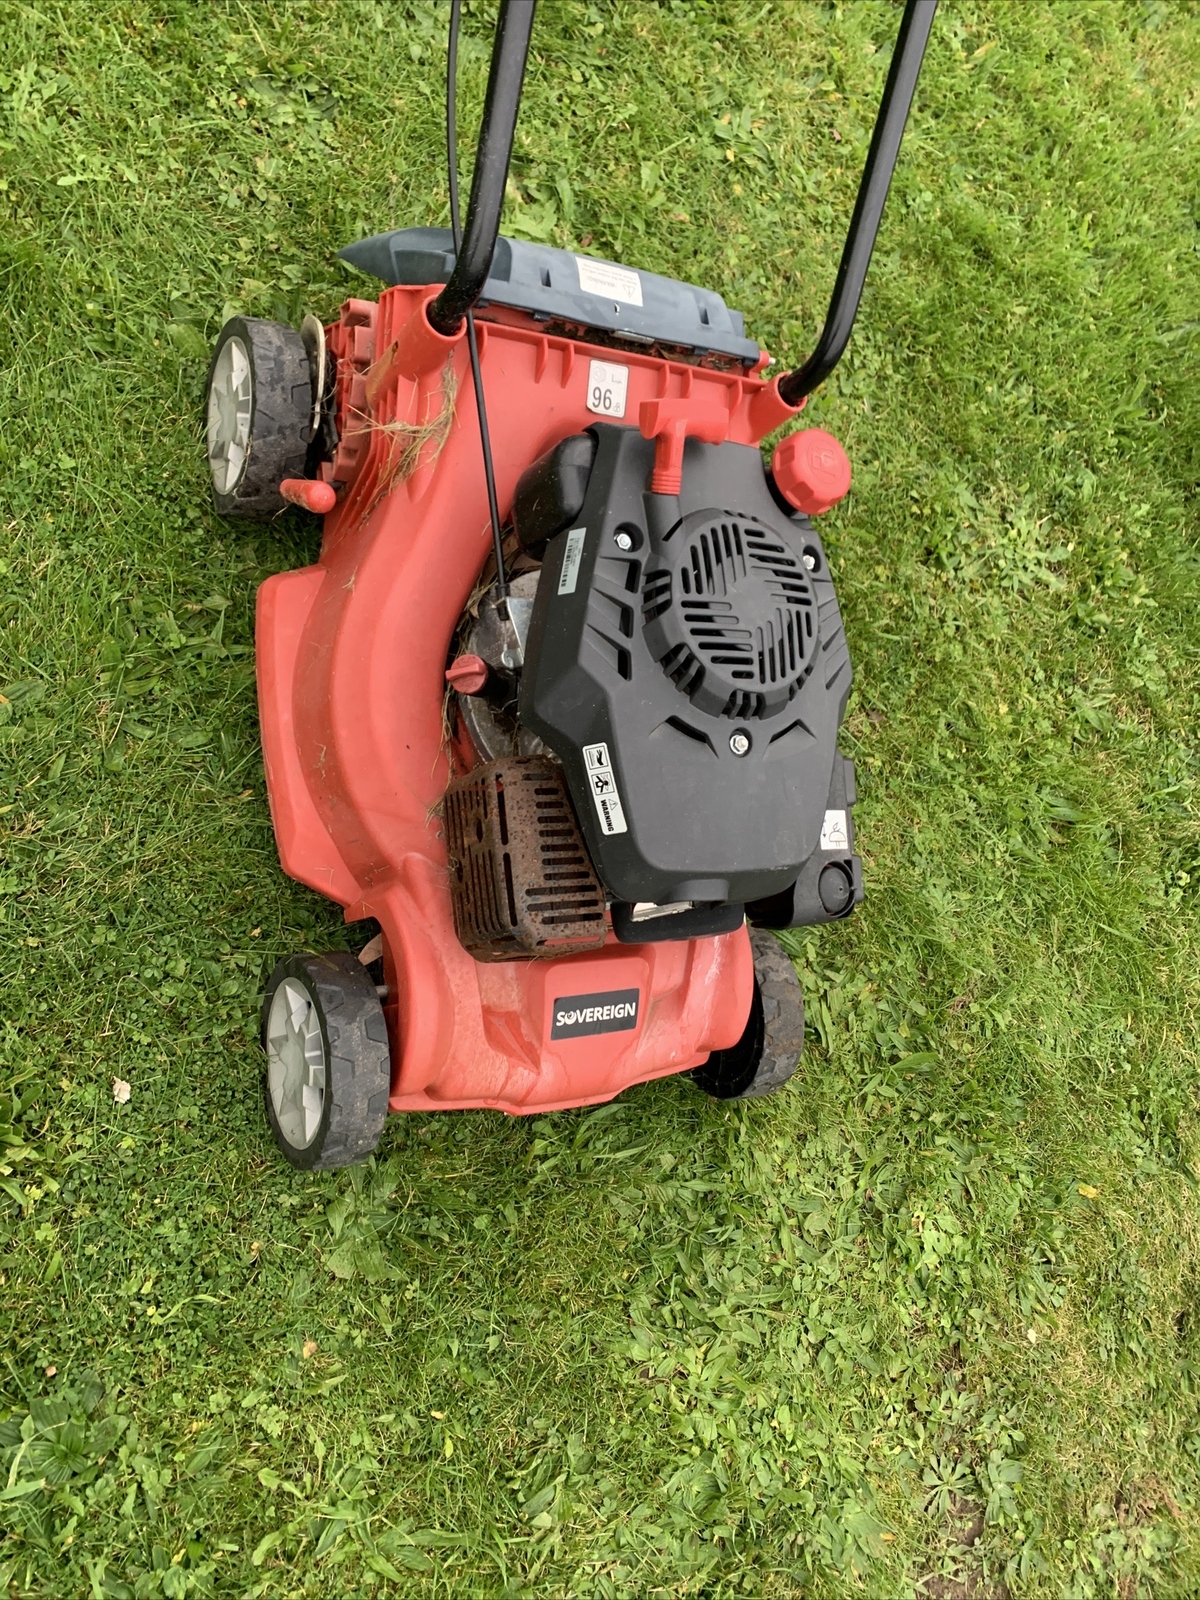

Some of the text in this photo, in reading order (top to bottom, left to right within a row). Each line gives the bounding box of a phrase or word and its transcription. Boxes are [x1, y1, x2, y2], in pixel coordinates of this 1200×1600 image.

[592, 386, 612, 411] 96
[600, 799, 614, 832] WARNING
[556, 1002, 636, 1026] SOVEREIGN
